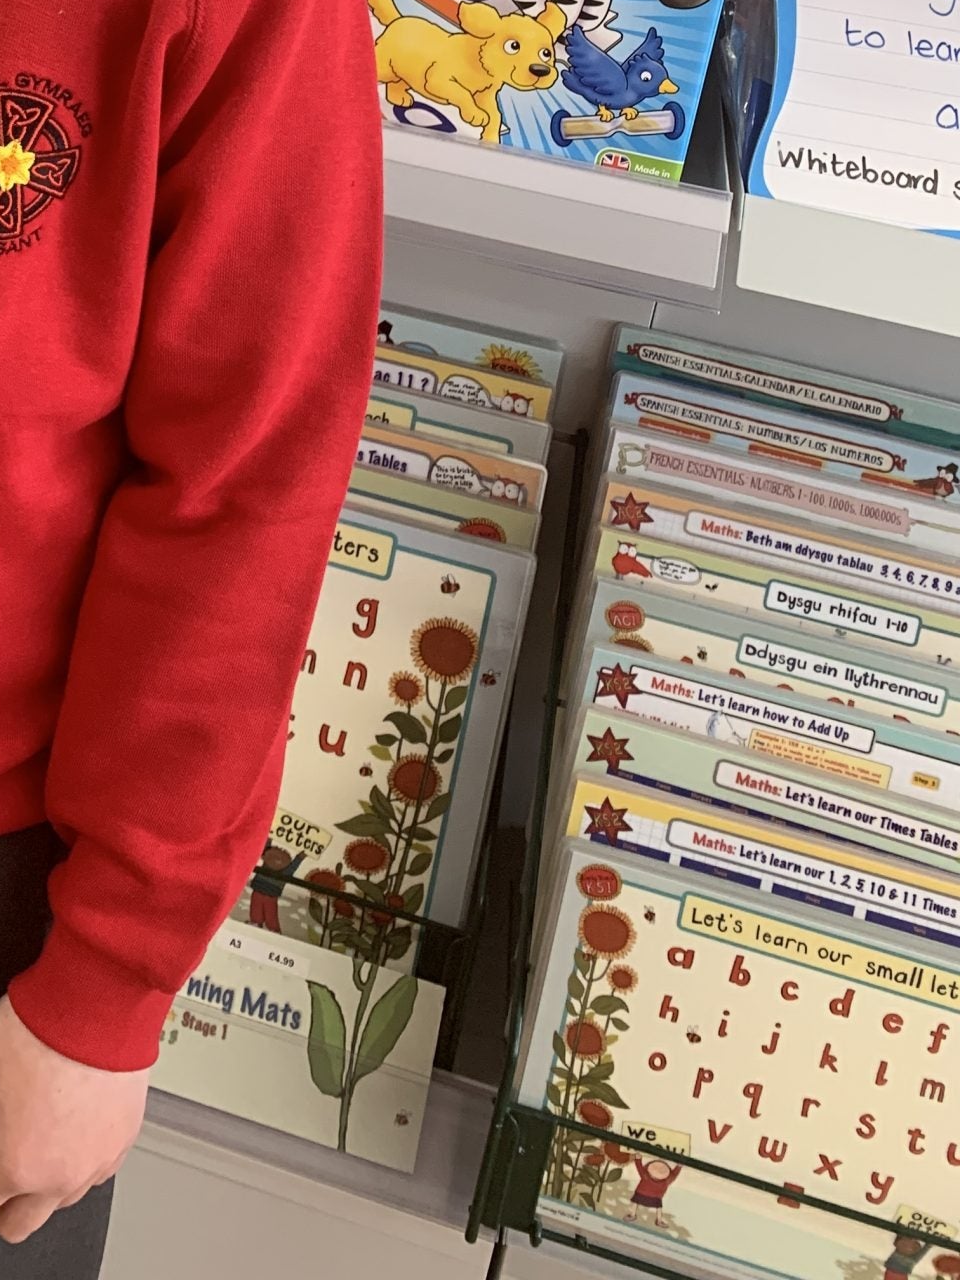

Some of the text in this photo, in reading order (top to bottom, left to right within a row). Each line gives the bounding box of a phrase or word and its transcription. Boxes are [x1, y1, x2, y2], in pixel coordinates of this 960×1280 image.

[846, 19, 885, 48] to
[15, 73, 93, 138] GYMRAEG
[634, 163, 670, 178] Made in
[777, 141, 939, 195] Whiteboard
[642, 348, 681, 367] SPANISH
[640, 397, 679, 416] SPANISH
[368, 449, 407, 473] Tables
[701, 519, 873, 572] Maths: Beth am ddysgu tablau
[777, 591, 908, 633] Dysgu rhifau 1-10
[745, 644, 939, 705] Ddysgu ein llythrennau
[651, 677, 850, 742] Maths: Let's learn how to Add Up
[735, 771, 958, 852] Maths: Let's learn our Times Tables
[268, 953, 294, 967] £4.99
[691, 906, 924, 988] Let's learn our small
[181, 1011, 227, 1040] Stage 1
[240, 987, 302, 1030] Mats
